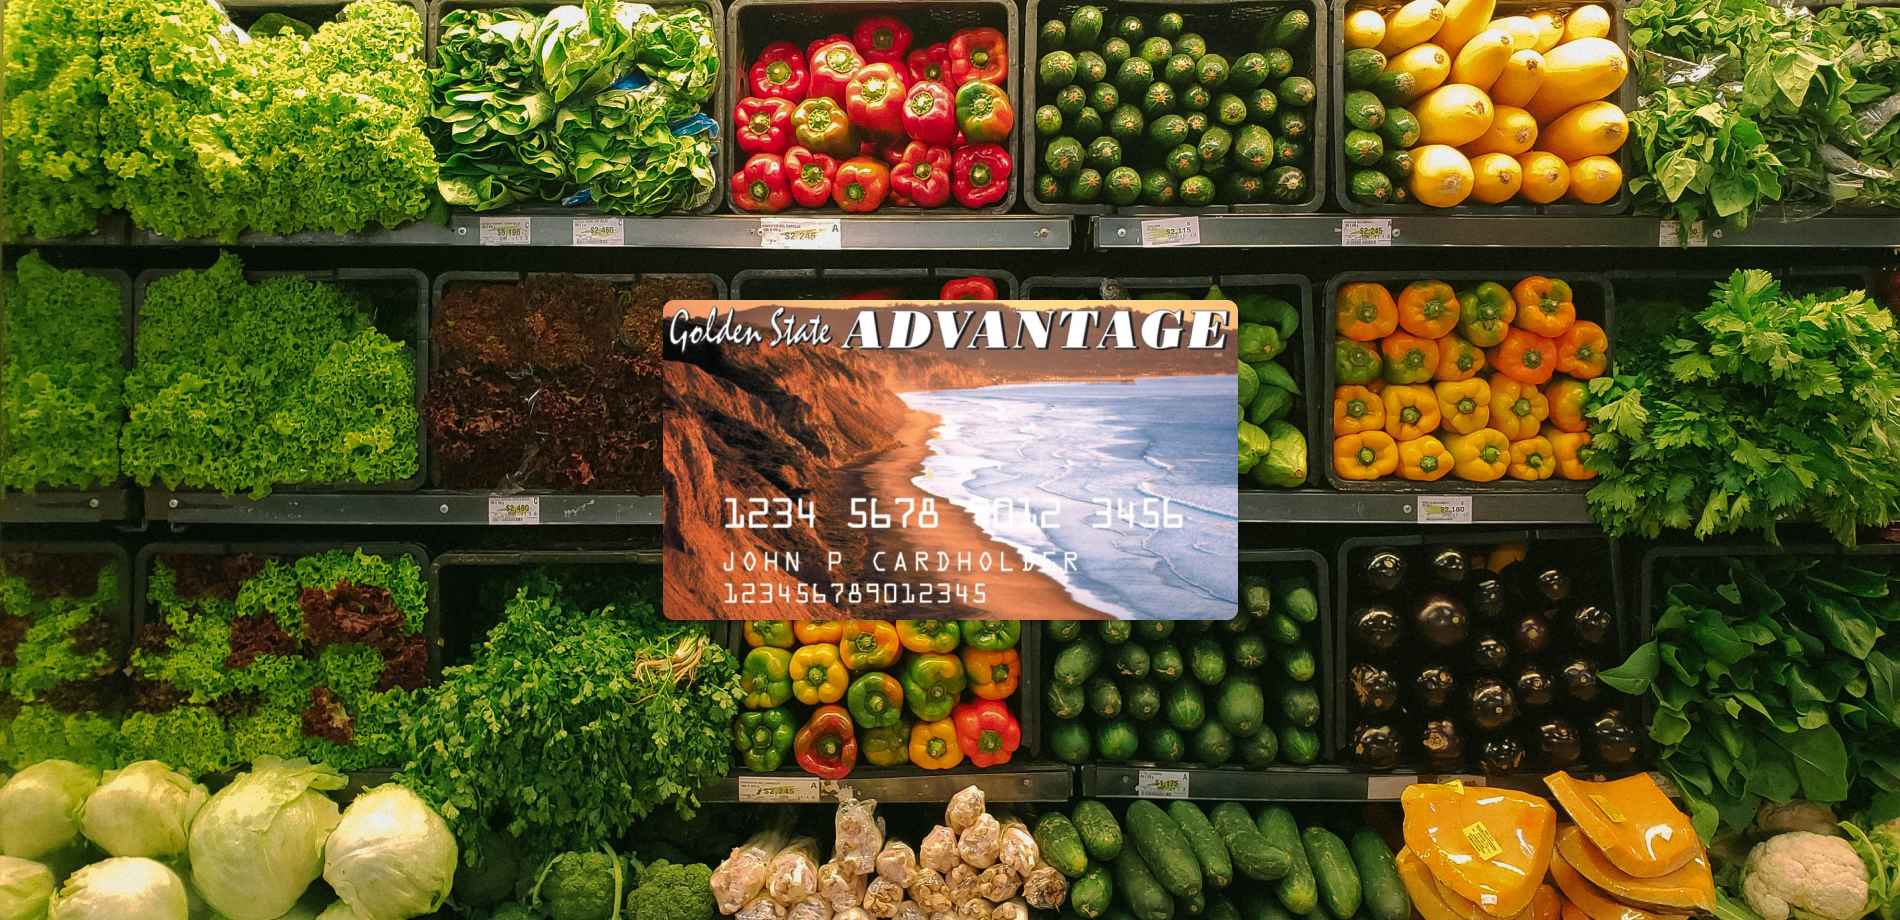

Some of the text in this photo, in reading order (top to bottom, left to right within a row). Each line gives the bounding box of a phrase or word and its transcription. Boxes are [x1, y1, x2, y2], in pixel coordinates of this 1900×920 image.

[525, 221, 530, 229] C
[618, 219, 623, 227] C
[1387, 220, 1393, 228] A
[832, 224, 839, 232] A
[533, 497, 538, 505] C
[1182, 773, 1188, 781] A
